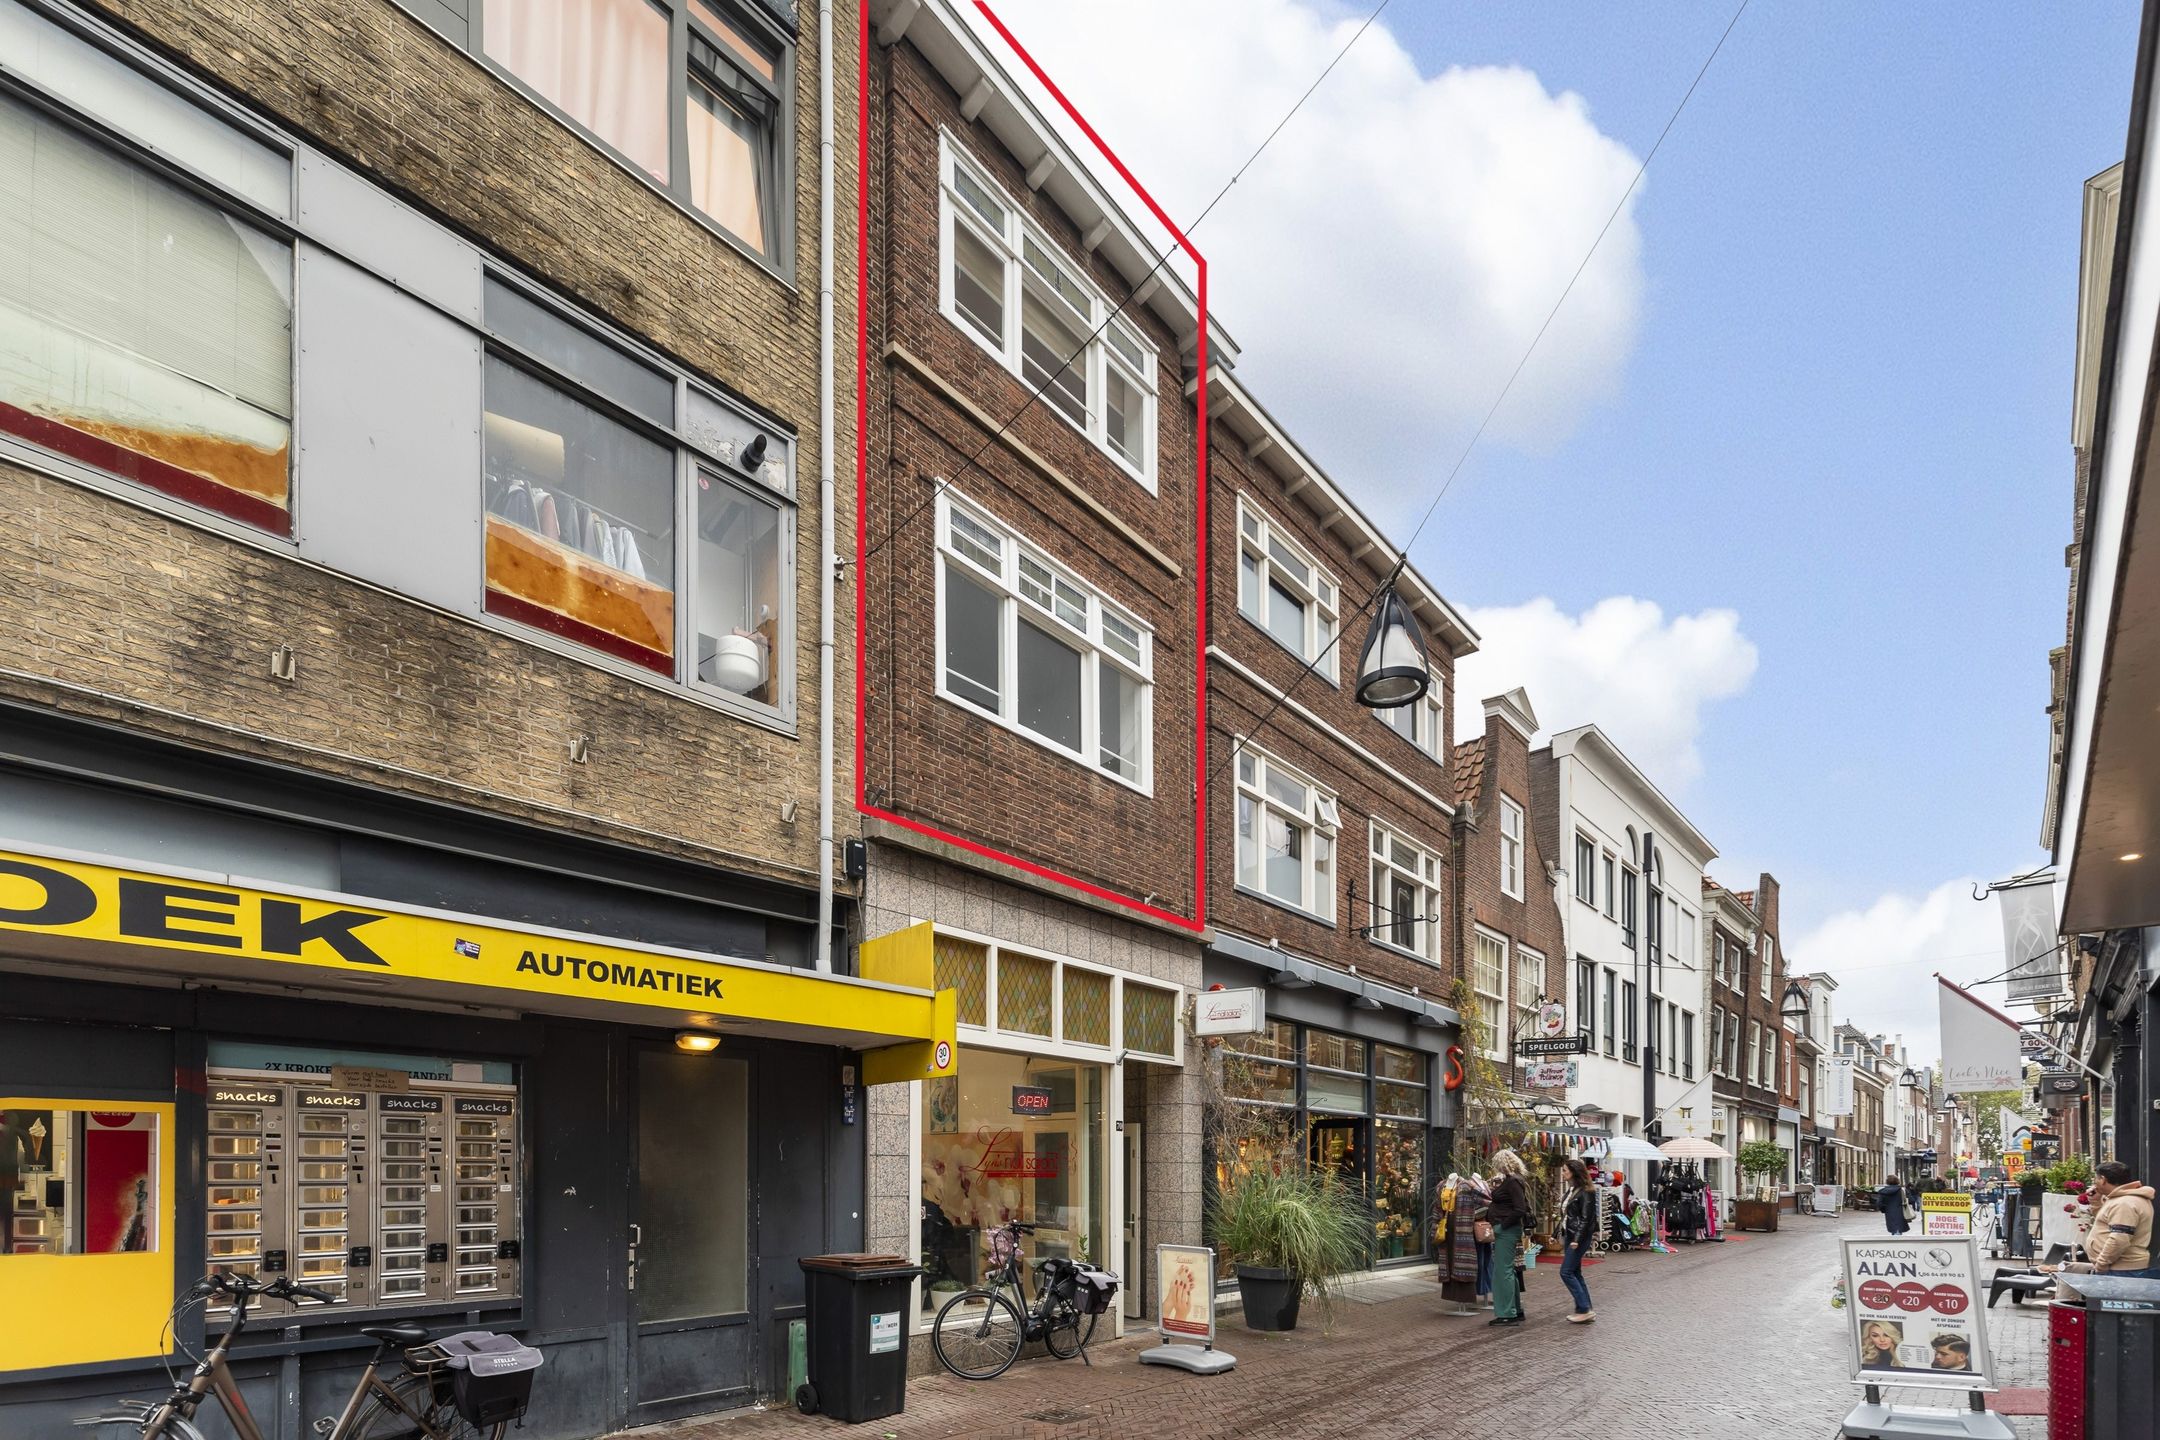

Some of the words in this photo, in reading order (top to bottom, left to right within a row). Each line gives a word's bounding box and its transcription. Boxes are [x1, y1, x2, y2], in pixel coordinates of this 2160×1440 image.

[515, 950, 724, 999] AUTOMATIEK
[939, 1046, 947, 1058] 30
[1528, 1043, 1576, 1051] SPEELGOED
[265, 1062, 282, 1071] 2X
[216, 1092, 277, 1103] snacks
[306, 1096, 361, 1106] snacks
[387, 1097, 437, 1109] snacks
[1017, 1095, 1048, 1108] OPEN
[461, 1101, 508, 1113] snacks
[1922, 1200, 1970, 1208] UITVERKOOP
[1929, 1222, 1965, 1230] KORTING
[1855, 1249, 1917, 1259] KAPSALON
[1857, 1261, 1917, 1278] ALAN
[1902, 1295, 1920, 1306] €20
[1945, 1299, 1958, 1310] 10
